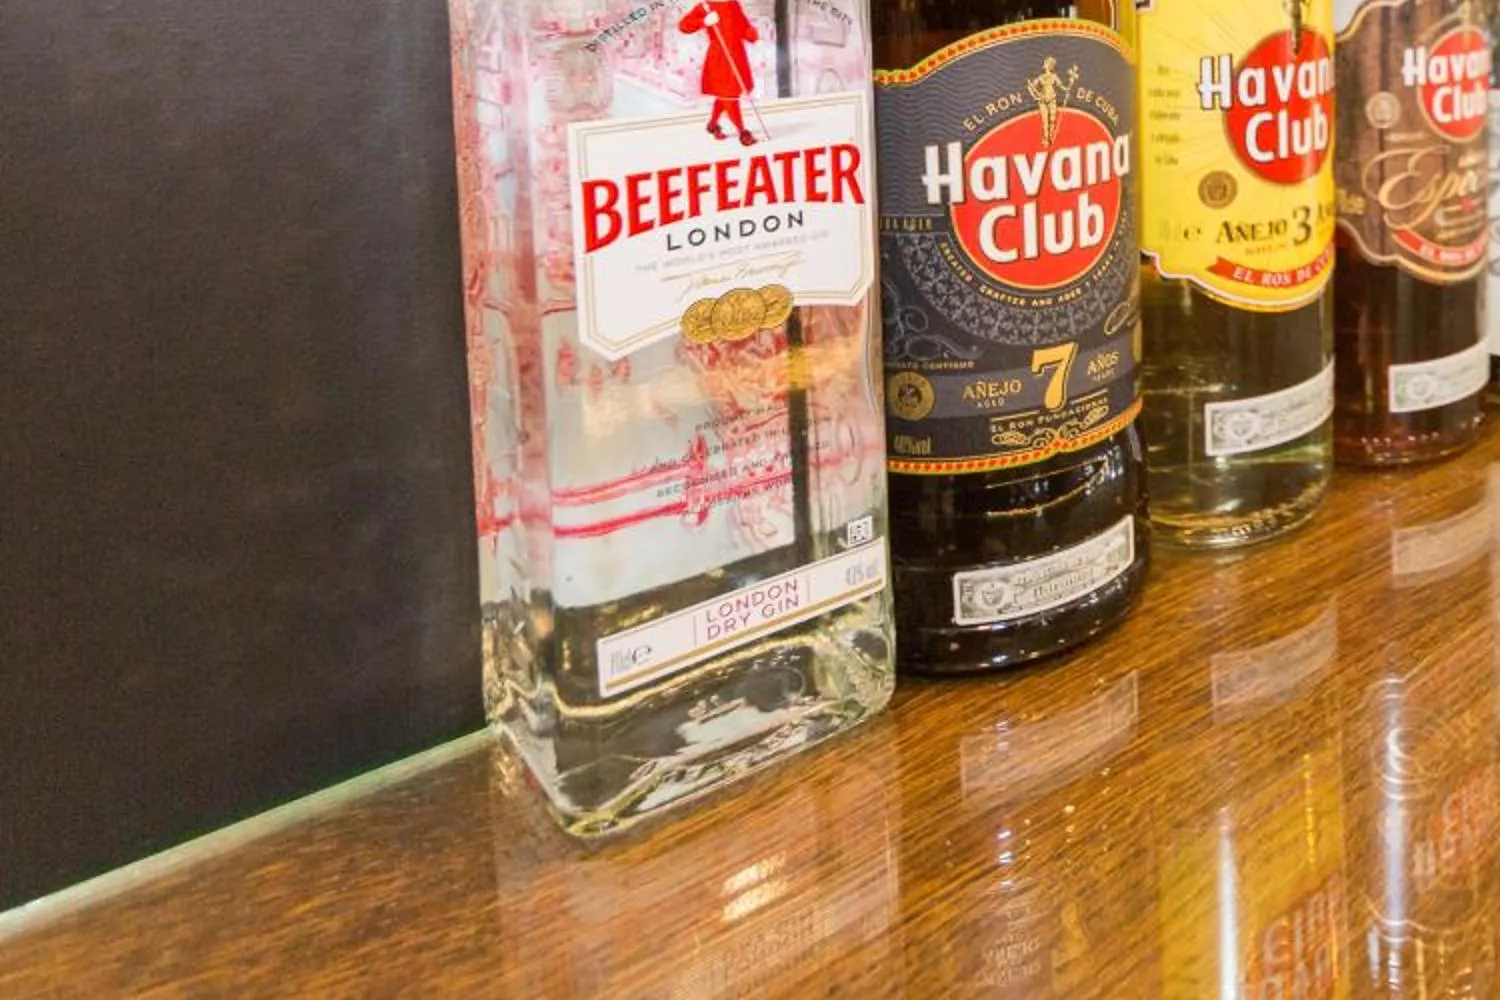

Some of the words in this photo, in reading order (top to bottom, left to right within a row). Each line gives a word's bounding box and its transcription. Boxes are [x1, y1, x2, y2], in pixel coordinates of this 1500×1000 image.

[985, 91, 1023, 118] RON
[1245, 103, 1329, 164] Club
[922, 133, 1131, 205] Havana
[581, 143, 866, 255] BEEFEATER
[666, 208, 805, 252] LONDON
[979, 192, 1106, 265] Club
[1291, 204, 1313, 246] 3
[1232, 268, 1256, 282] EL
[962, 378, 1023, 401] AÑEJO
[1031, 341, 1078, 411] 7
[705, 577, 800, 623] LONDON
[706, 609, 751, 641] DRY
[760, 595, 800, 619] GIN
